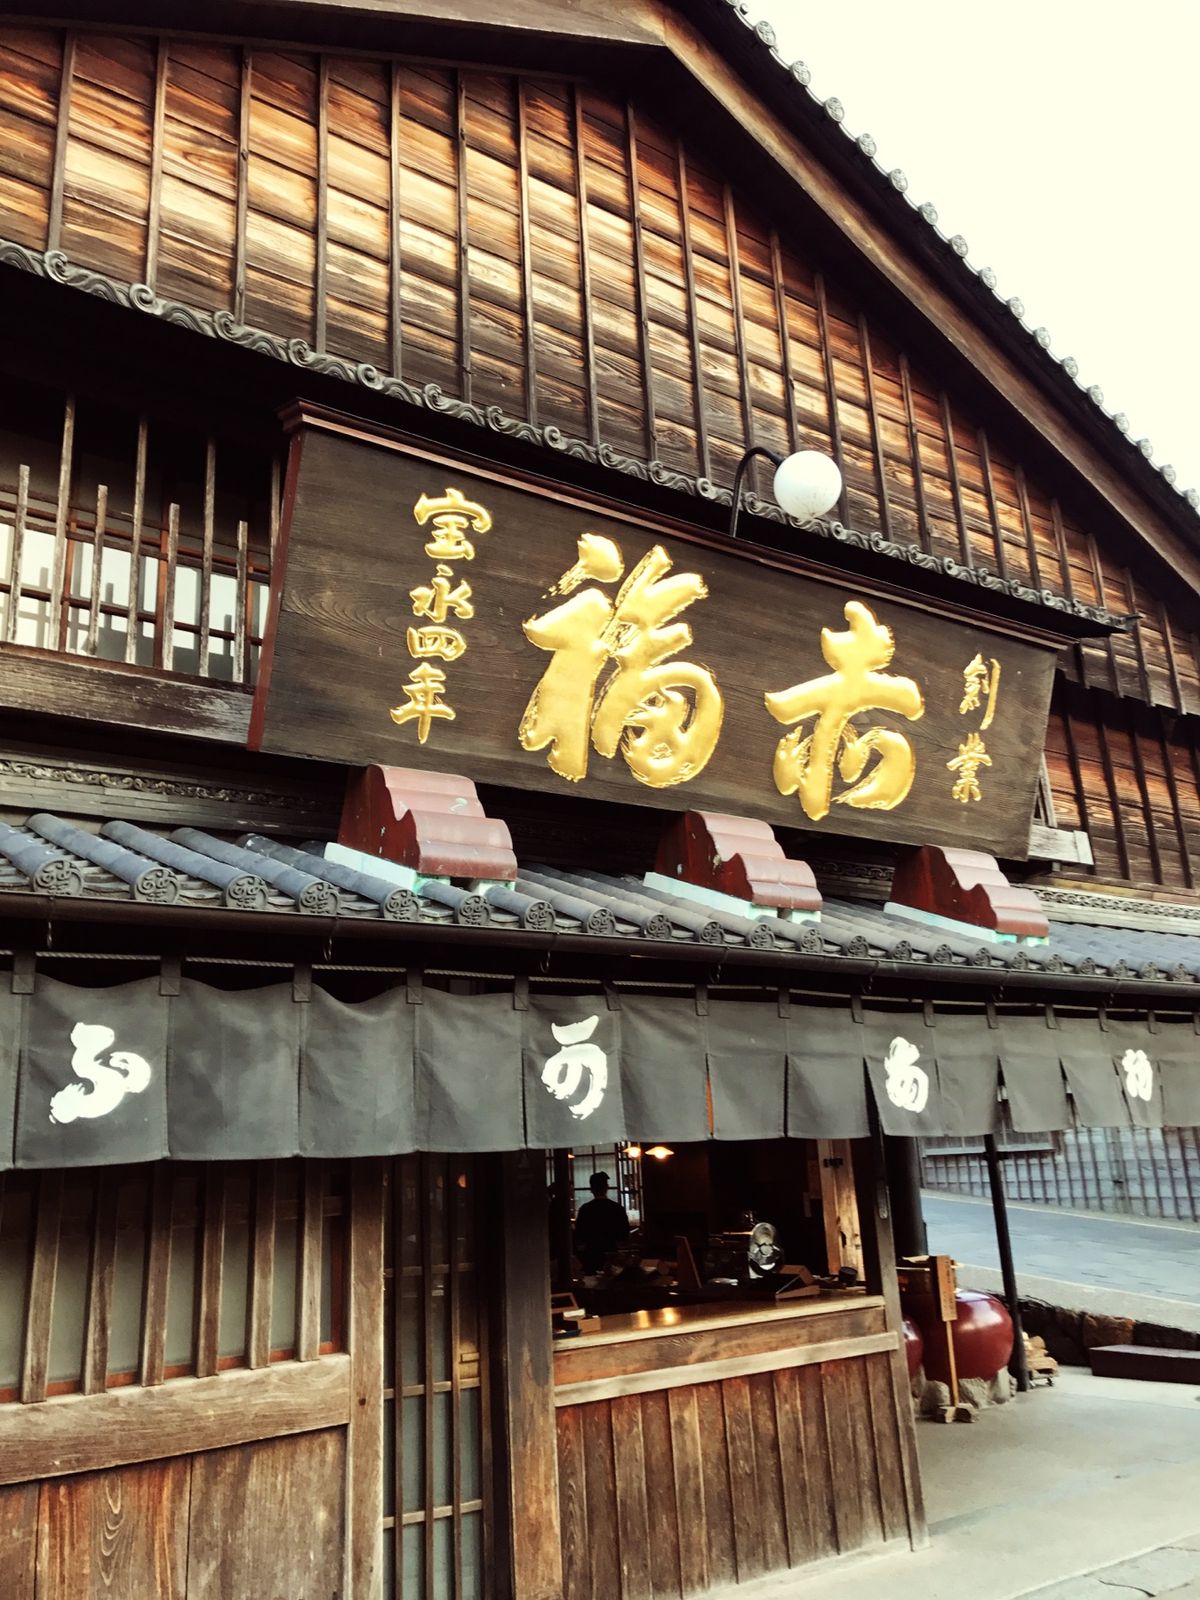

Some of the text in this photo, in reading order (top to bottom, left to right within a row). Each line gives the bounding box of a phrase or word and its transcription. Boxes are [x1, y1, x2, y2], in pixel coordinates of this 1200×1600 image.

[390, 488, 493, 745] 宝永四年
[946, 653, 1002, 804] 創業
